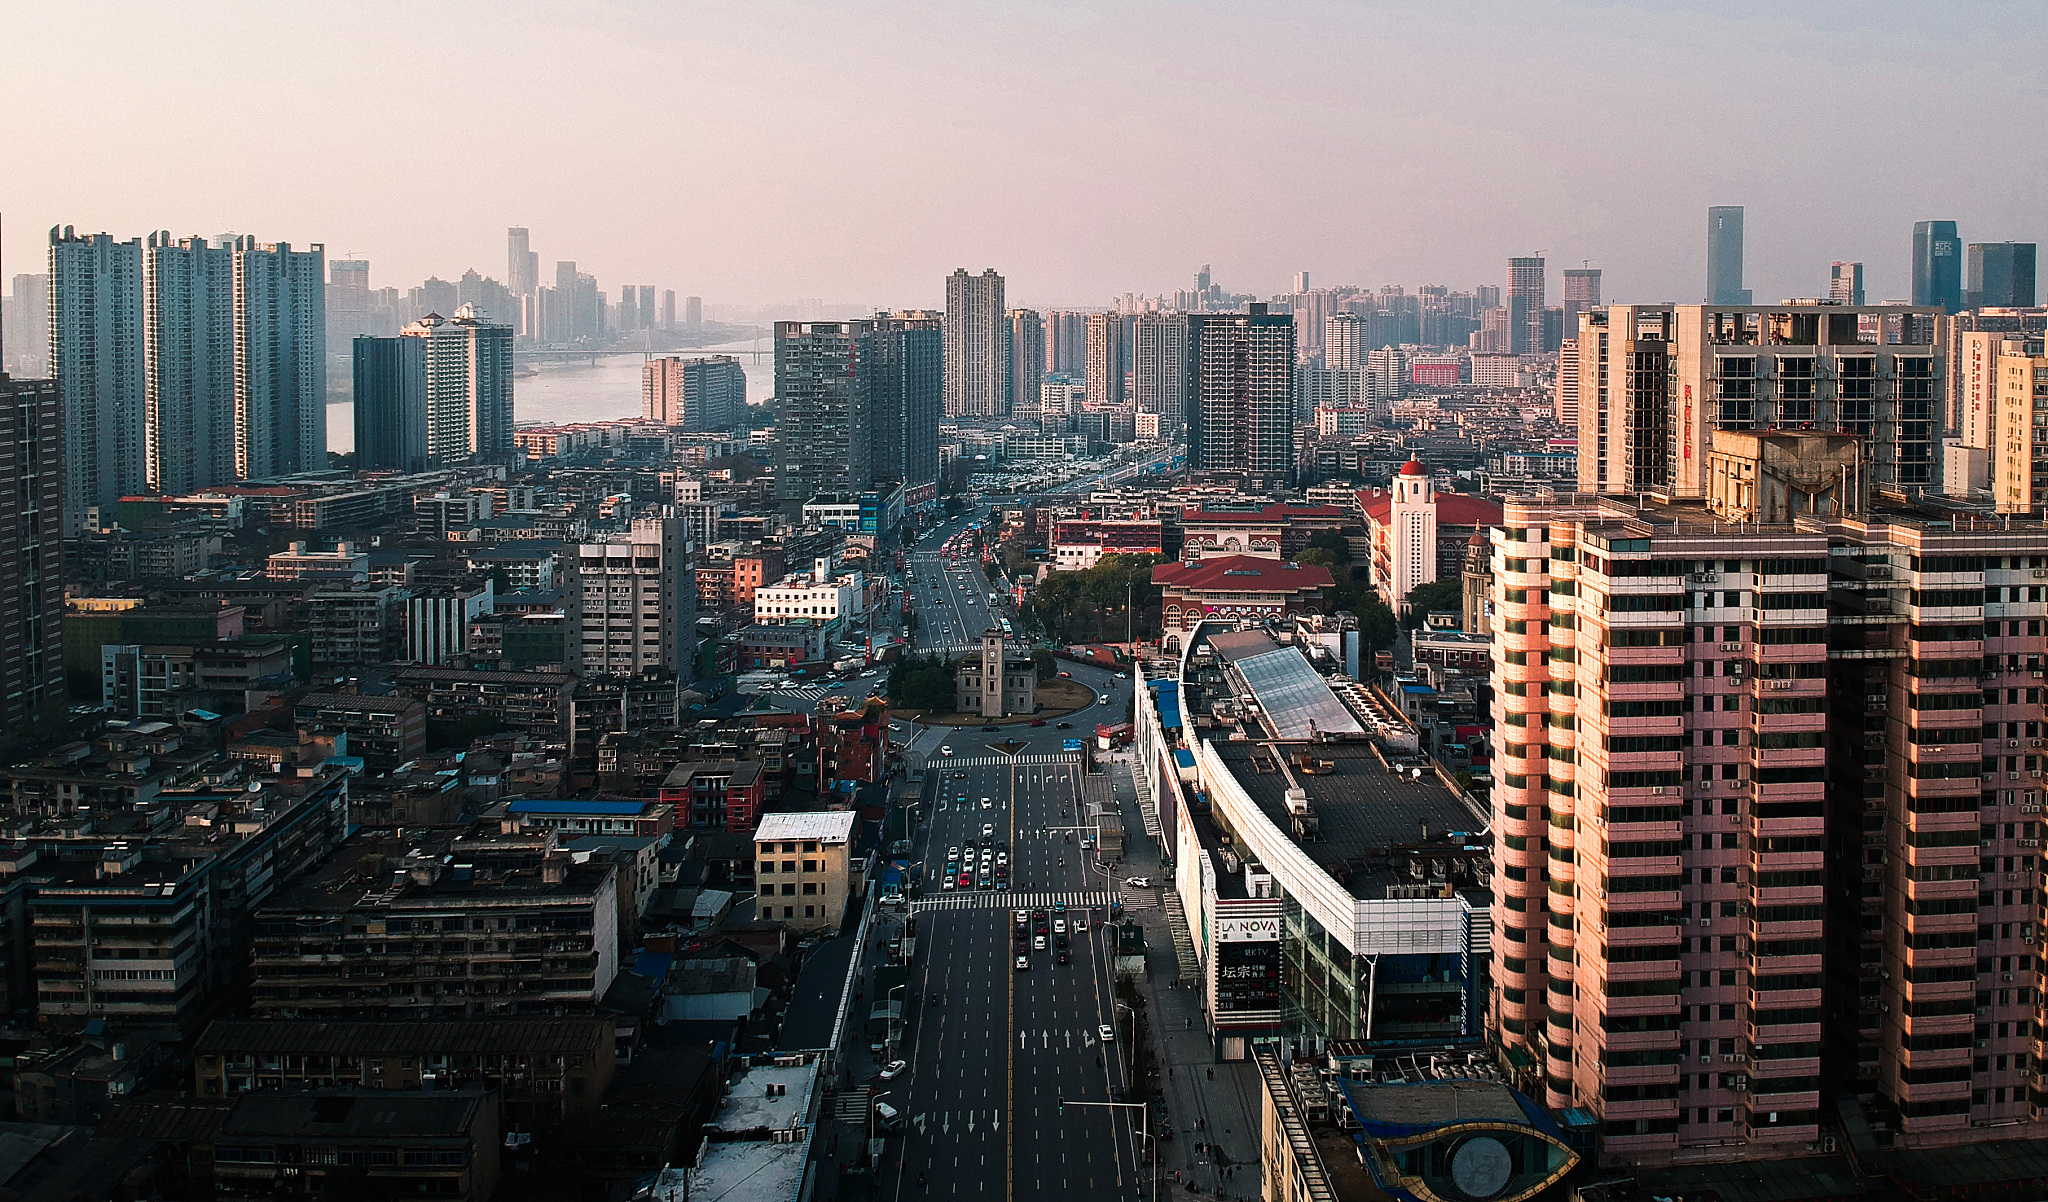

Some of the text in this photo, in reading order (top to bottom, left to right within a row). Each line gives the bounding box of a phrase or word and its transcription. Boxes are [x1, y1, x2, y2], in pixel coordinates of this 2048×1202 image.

[1222, 921, 1277, 932] LA NOVA
[1222, 964, 1251, 979] 坛宗
